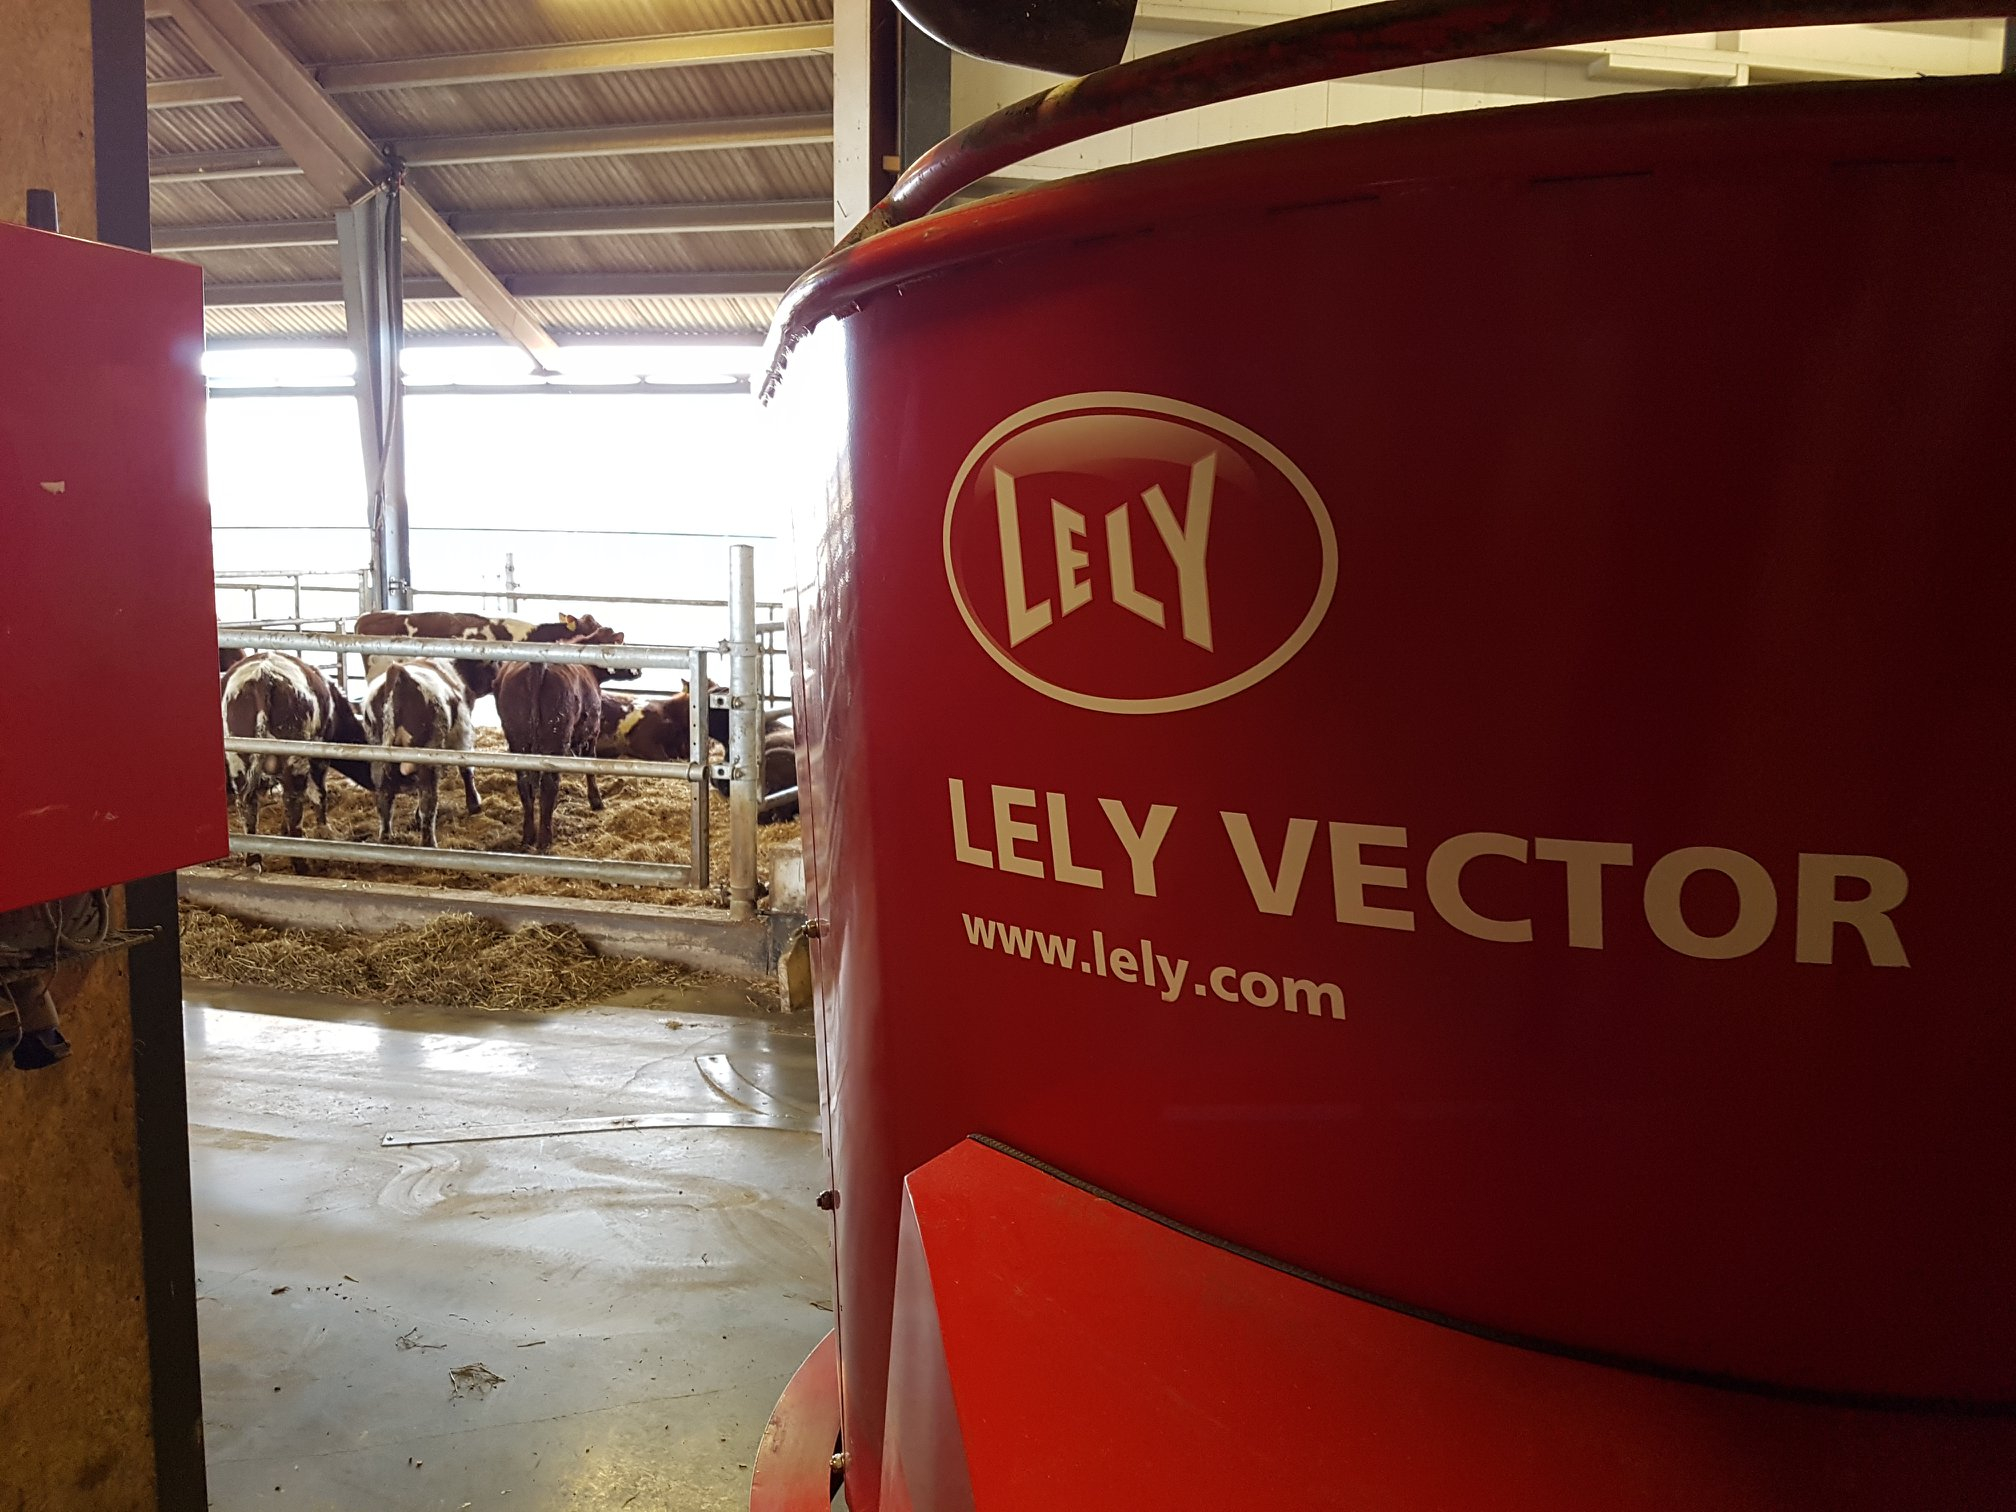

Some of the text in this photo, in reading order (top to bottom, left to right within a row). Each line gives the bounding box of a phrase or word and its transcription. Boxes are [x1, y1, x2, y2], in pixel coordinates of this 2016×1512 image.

[994, 451, 1217, 652] LELY
[949, 778, 1911, 968] LELY VECTOR
[962, 913, 1346, 1020] www.lely.com
